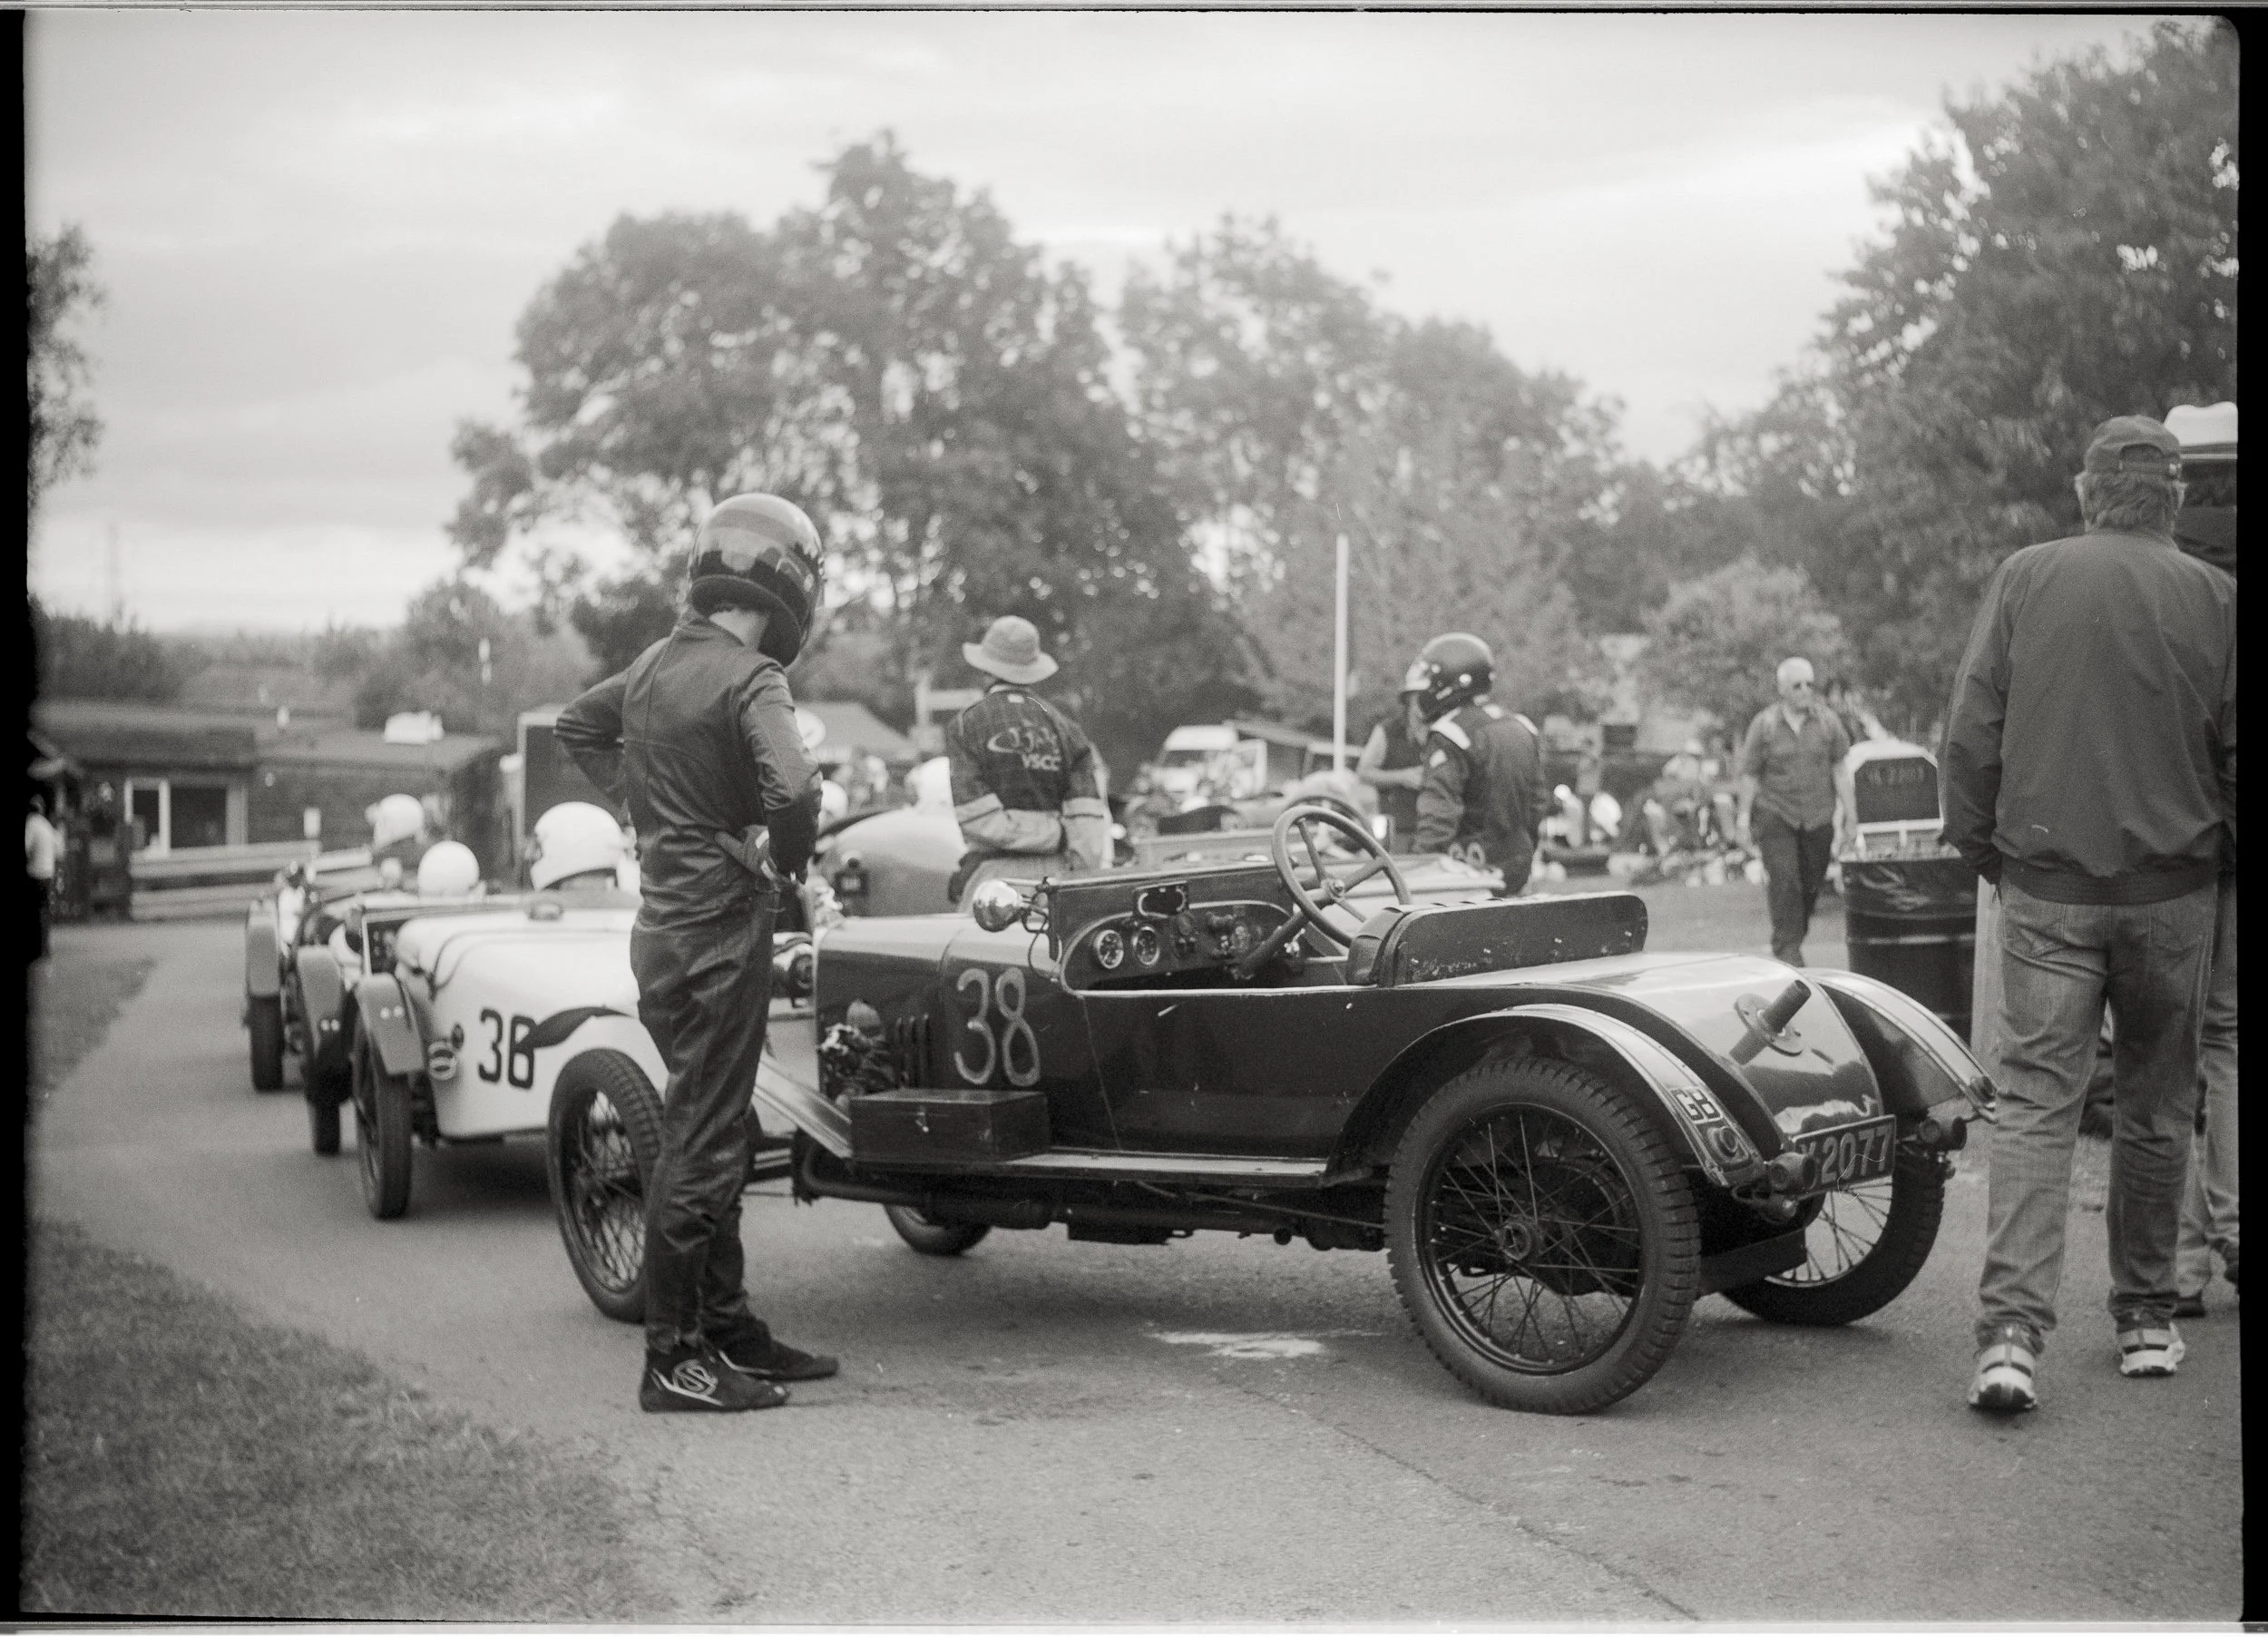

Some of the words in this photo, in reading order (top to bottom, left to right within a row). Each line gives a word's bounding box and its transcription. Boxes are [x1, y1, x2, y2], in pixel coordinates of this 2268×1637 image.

[1022, 753, 1061, 771] VSCC
[953, 966, 1041, 1087] 38
[1670, 1089, 1722, 1122] GB
